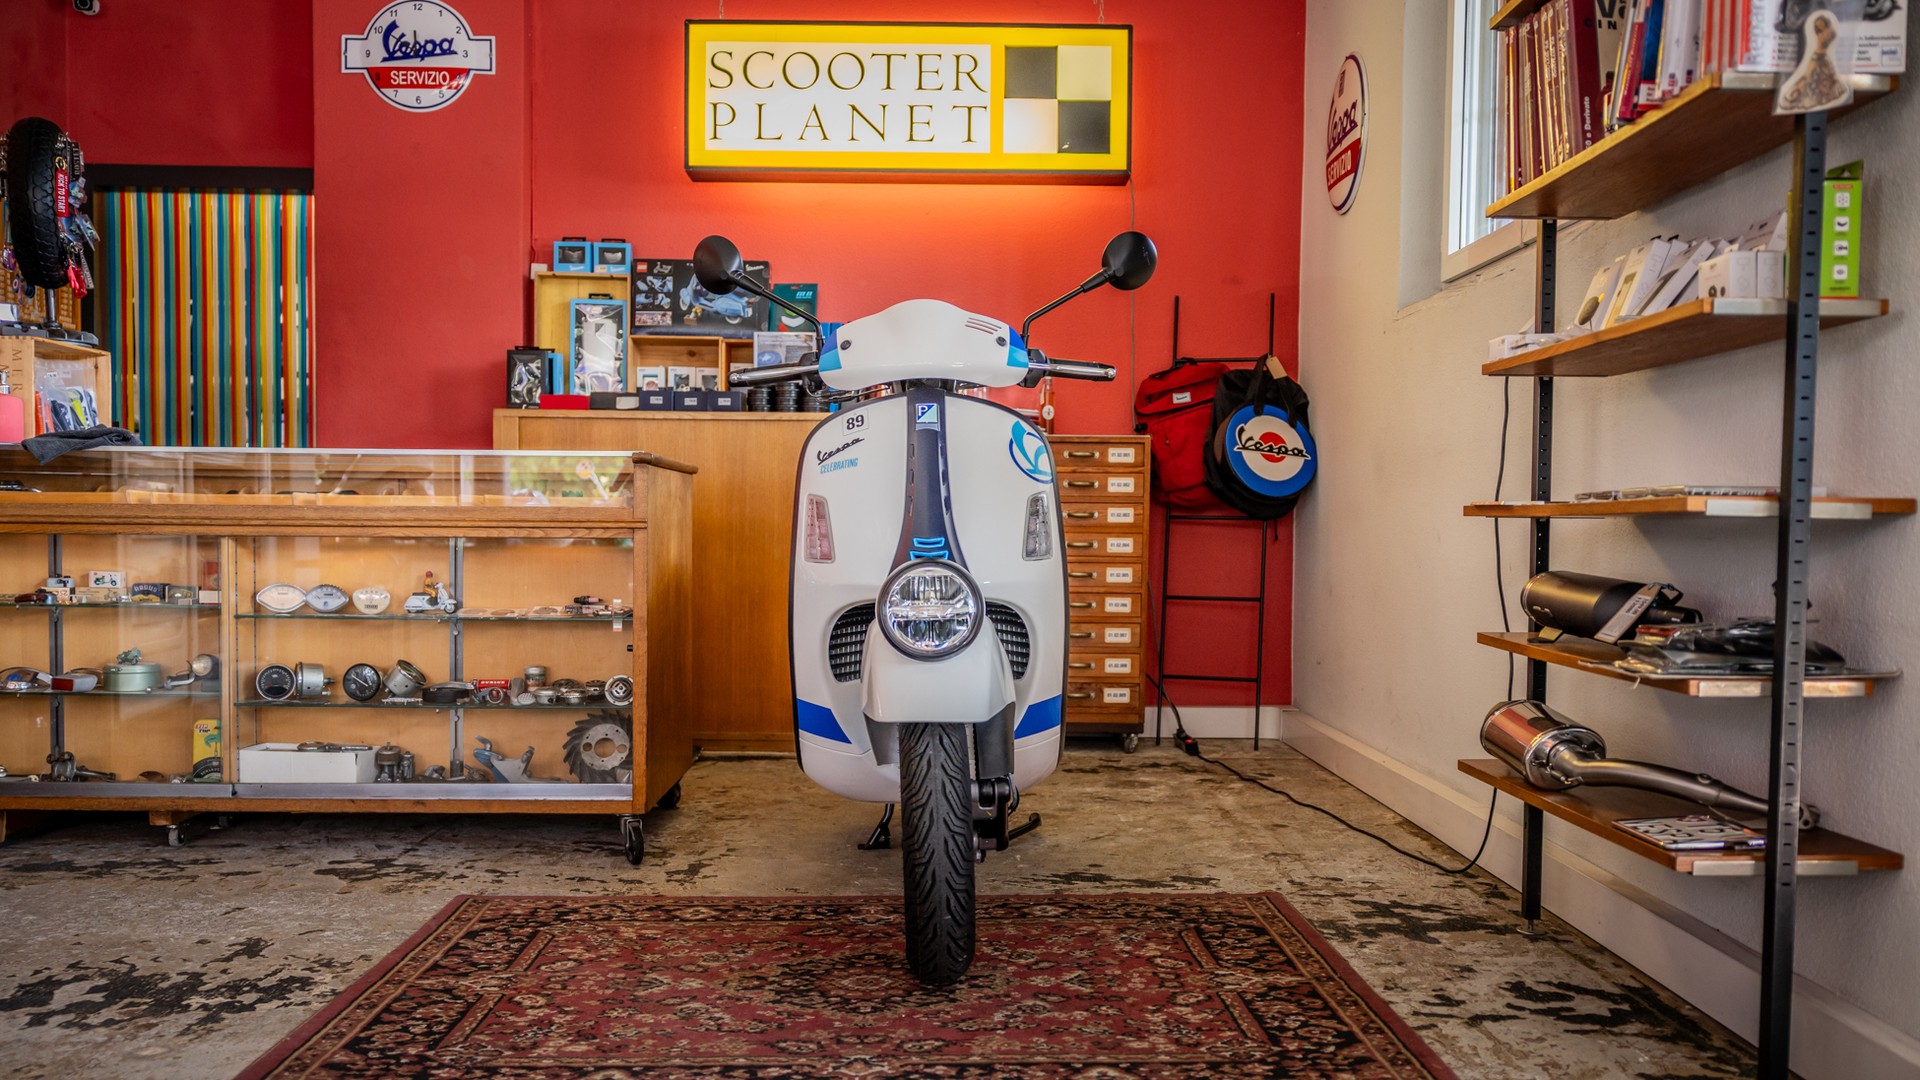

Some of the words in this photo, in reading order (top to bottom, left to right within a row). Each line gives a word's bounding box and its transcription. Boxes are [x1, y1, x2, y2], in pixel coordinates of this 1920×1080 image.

[413, 3, 423, 11] 12
[373, 26, 383, 34] 10
[455, 26, 462, 34] 2
[380, 19, 459, 62] Vespa
[365, 50, 371, 58] 9
[462, 50, 469, 58] 3
[390, 70, 450, 85] SERVIZIO
[708, 50, 989, 93] SCOOTER
[393, 90, 399, 98] 7
[415, 96, 422, 104] 6
[438, 90, 445, 98] 5
[1584, 96, 1592, 131] Derivate
[708, 101, 989, 144] PLANET
[1327, 150, 1352, 186] SERVIZIO
[57, 195, 66, 213] START
[846, 414, 865, 431] 89
[1235, 424, 1311, 460] Vespa
[817, 437, 865, 466] Vespa
[820, 457, 859, 475] CELEBRATING
